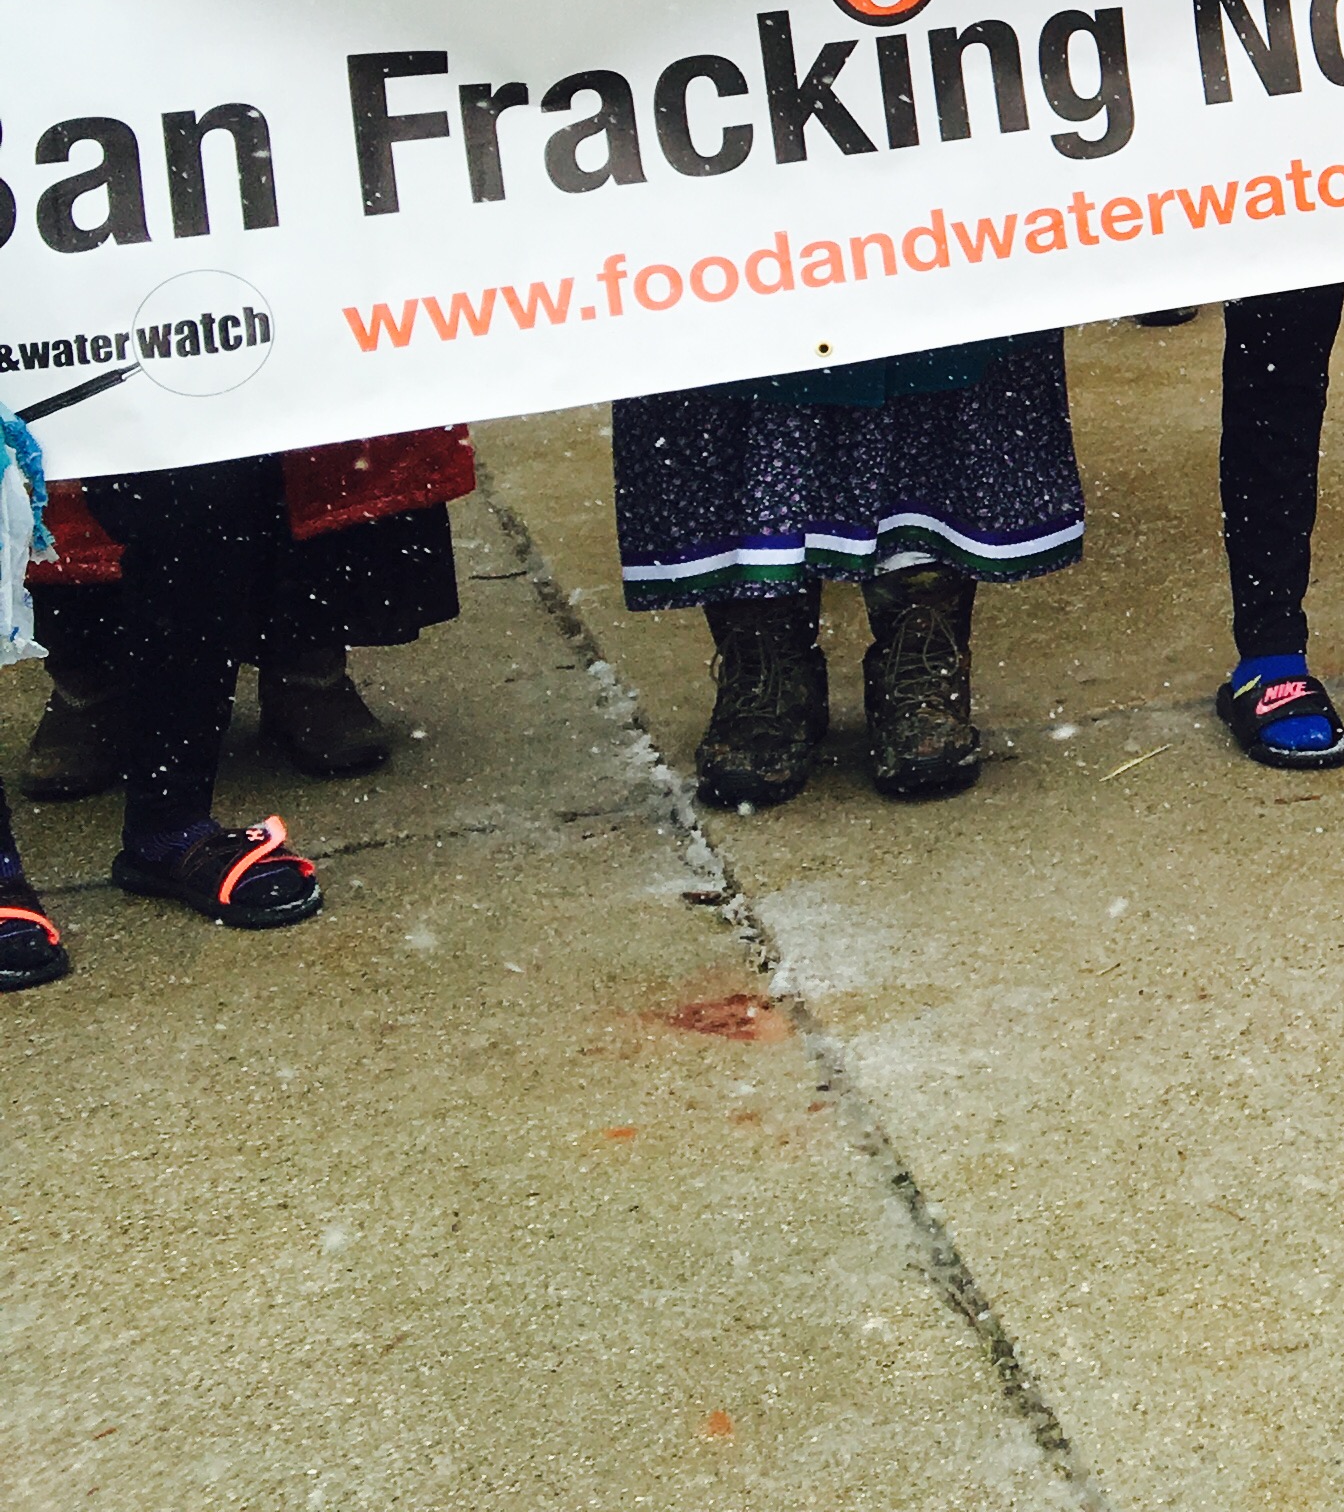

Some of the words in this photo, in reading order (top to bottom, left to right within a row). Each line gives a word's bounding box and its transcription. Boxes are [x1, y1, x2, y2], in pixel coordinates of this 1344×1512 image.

[0, 102, 279, 254] an
[347, 7, 1135, 217] Fracking
[1264, 681, 1307, 703] NIKE
